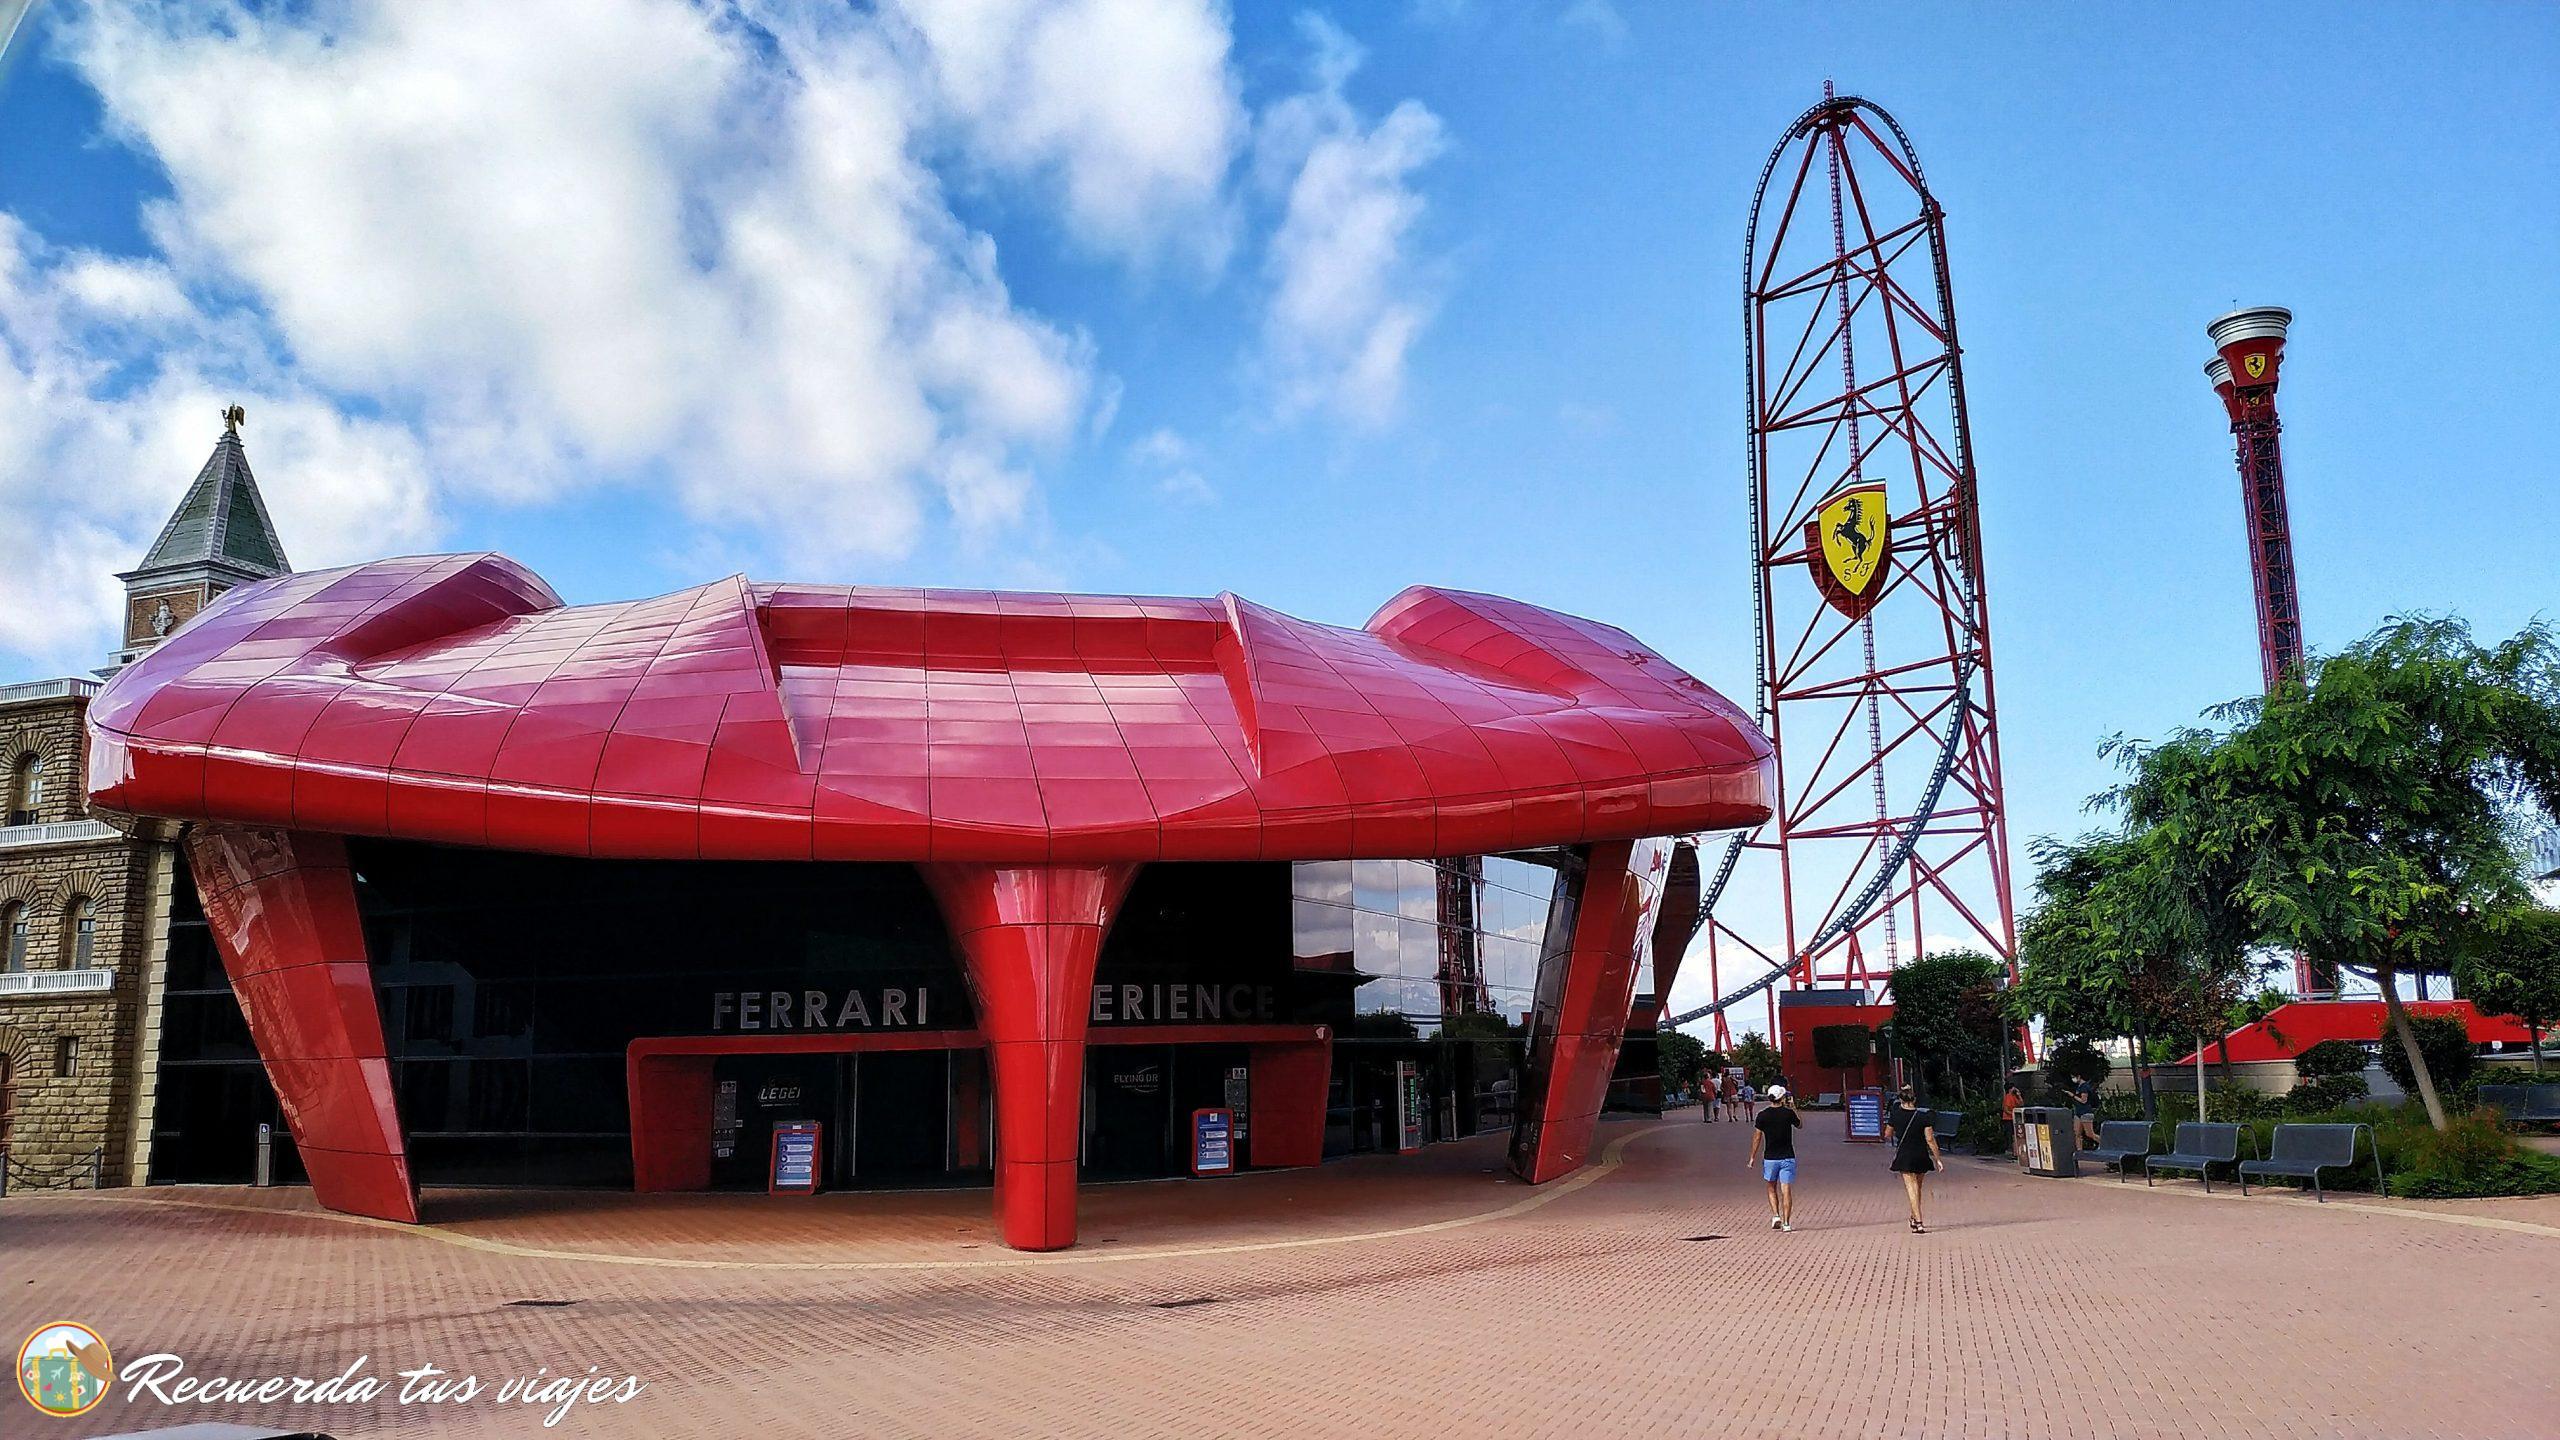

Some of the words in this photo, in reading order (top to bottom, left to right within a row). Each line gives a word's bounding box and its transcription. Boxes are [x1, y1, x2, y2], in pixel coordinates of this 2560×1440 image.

[1843, 569, 1852, 582] S
[713, 987, 927, 1030] FERRARI
[1093, 984, 1274, 1021] ERIENCE
